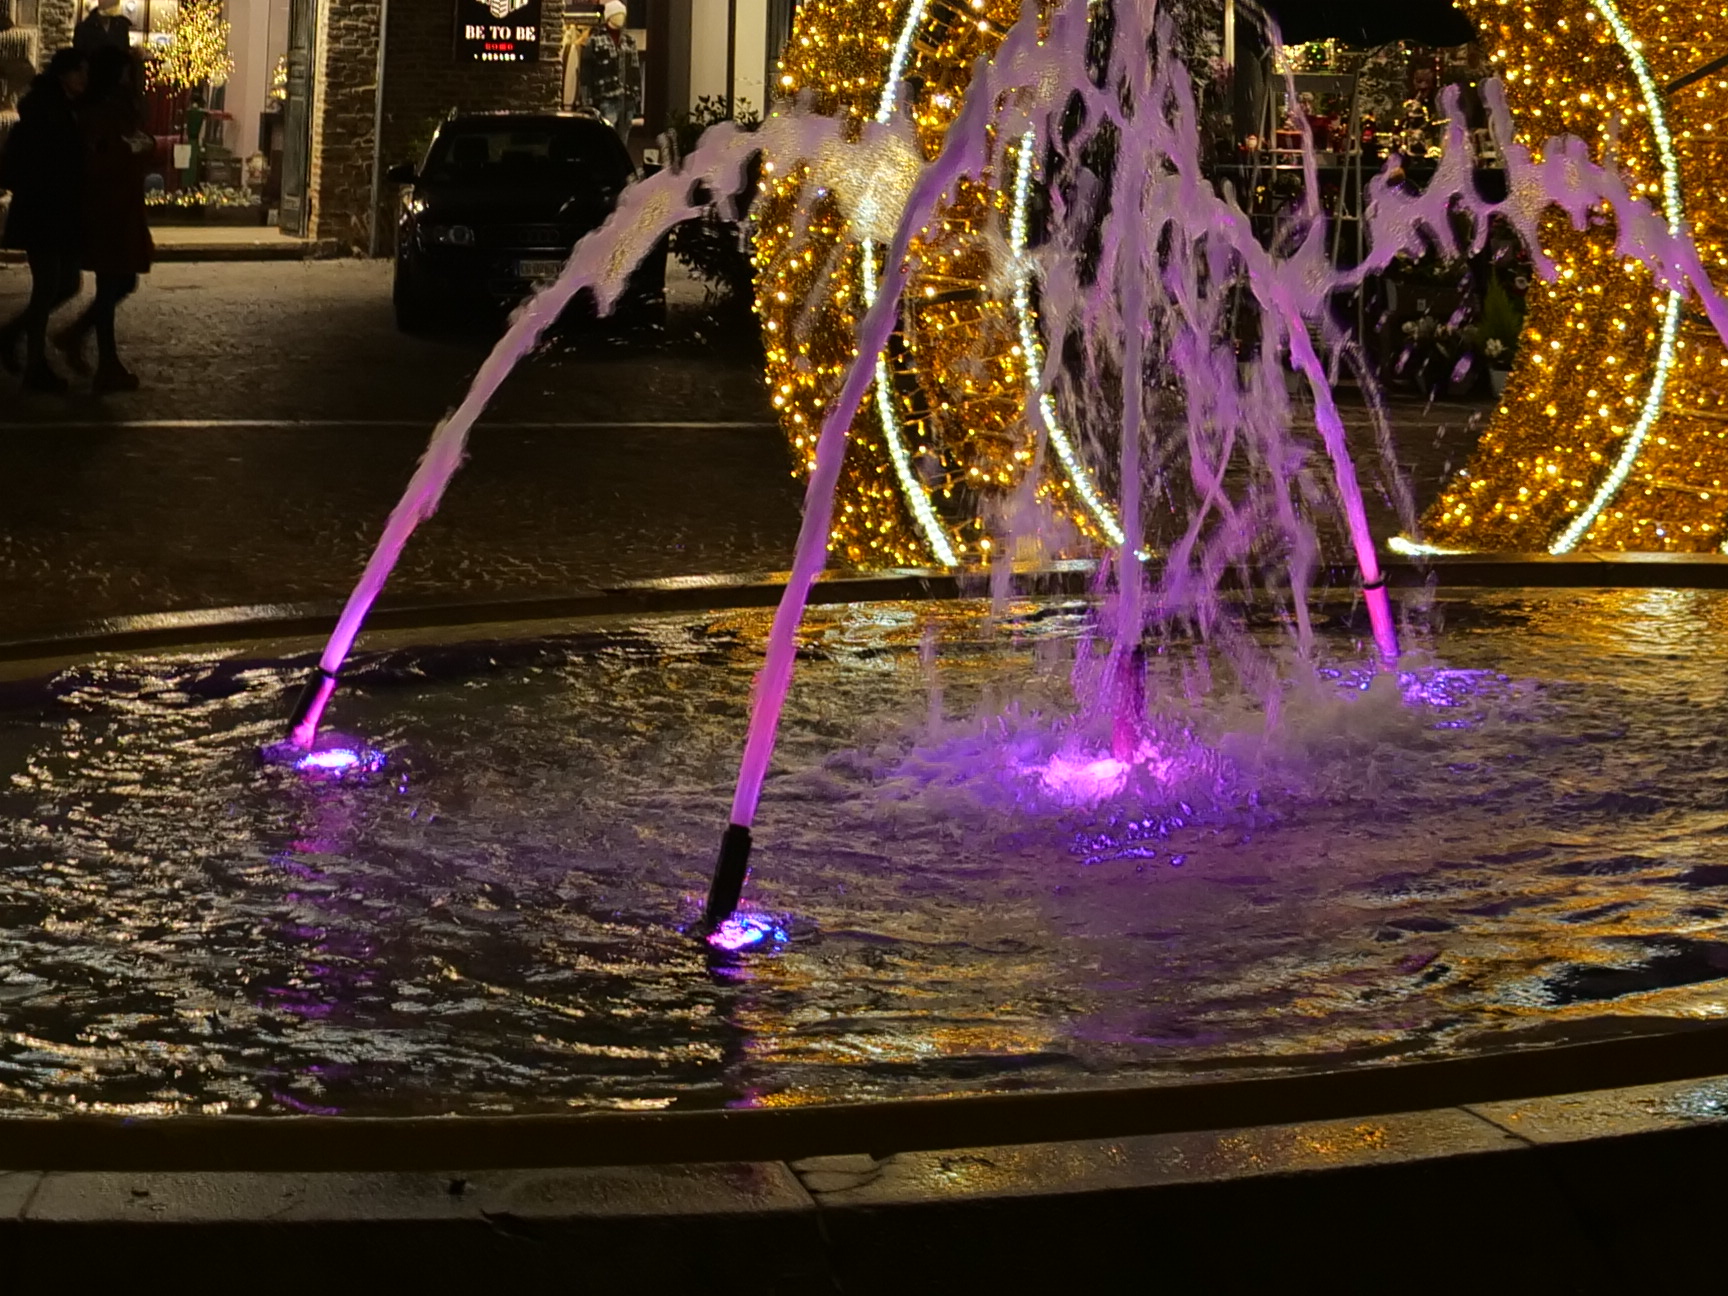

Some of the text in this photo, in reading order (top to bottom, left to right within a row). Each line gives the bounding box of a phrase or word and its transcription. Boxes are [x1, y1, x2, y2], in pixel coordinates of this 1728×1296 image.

[465, 24, 536, 42] BE TO BE
